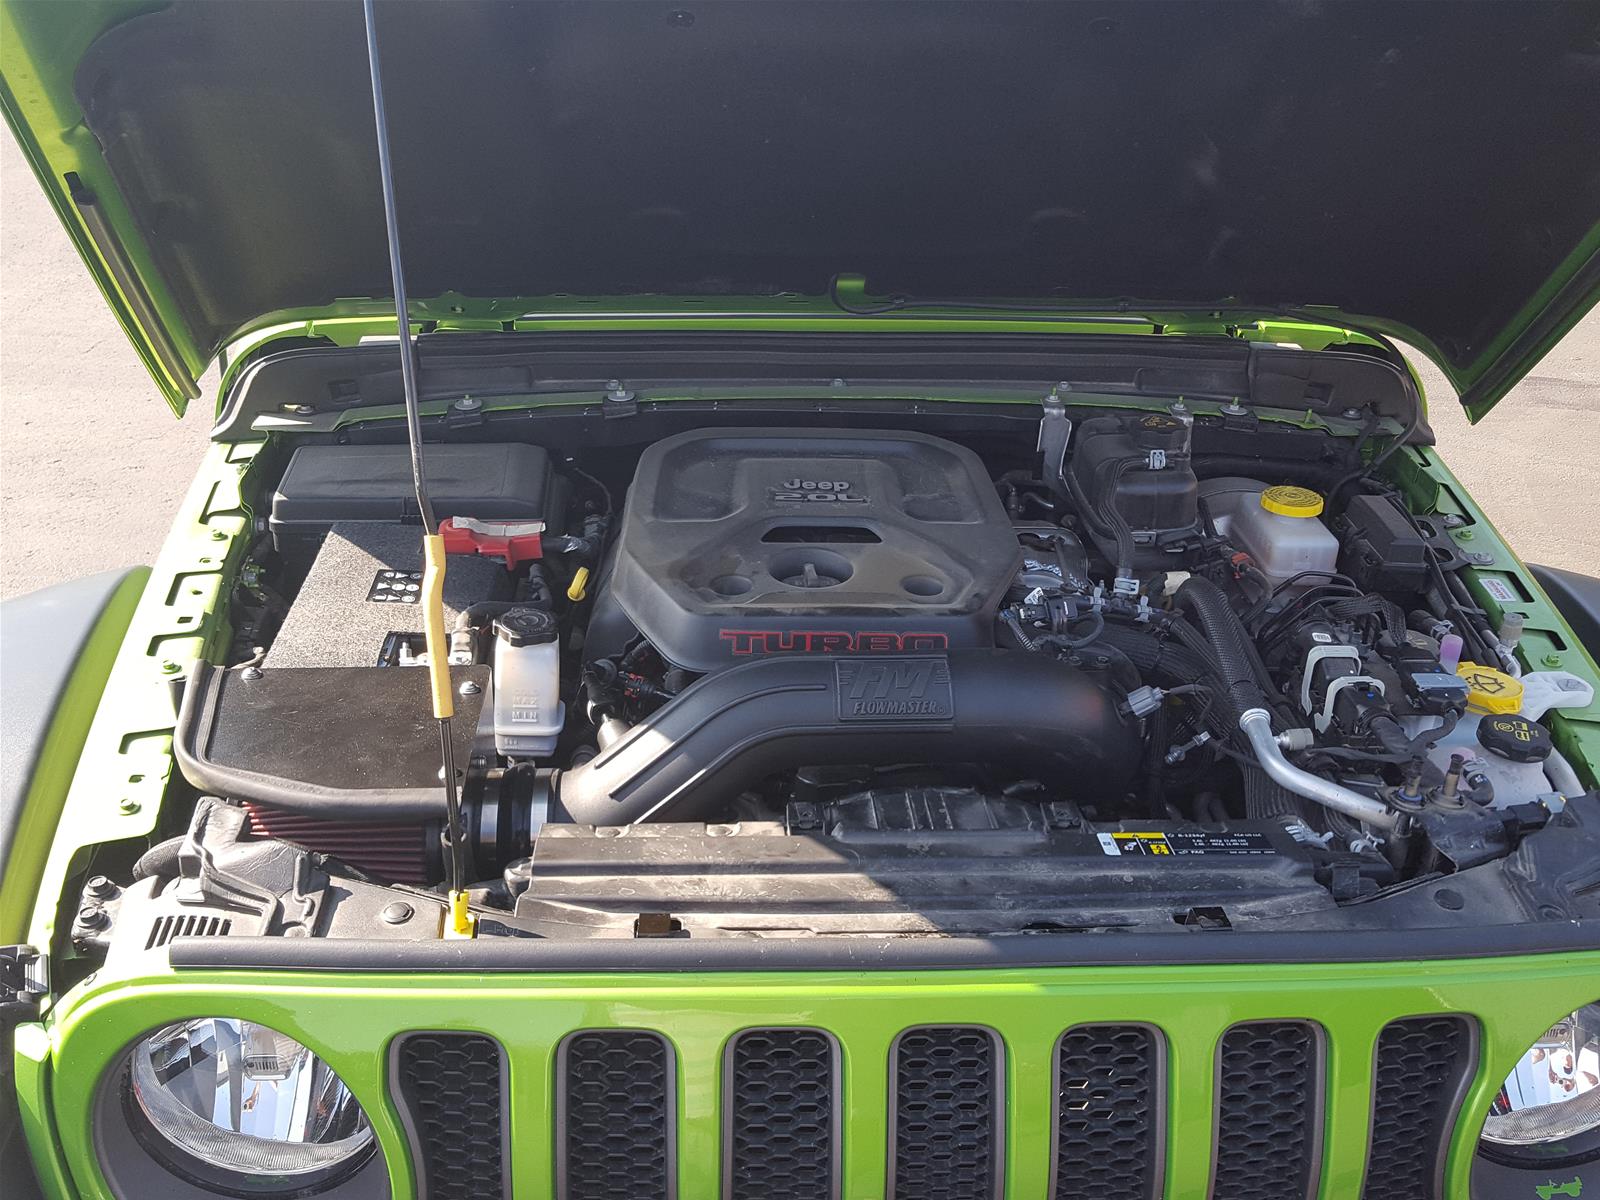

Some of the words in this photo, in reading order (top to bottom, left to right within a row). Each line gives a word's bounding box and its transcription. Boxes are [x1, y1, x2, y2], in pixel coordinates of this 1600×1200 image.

[783, 478, 850, 492] Jeep
[719, 628, 949, 655] TURBO
[849, 661, 936, 699] FM
[511, 711, 537, 719] MIN
[853, 700, 938, 717] FLOWMASTER
